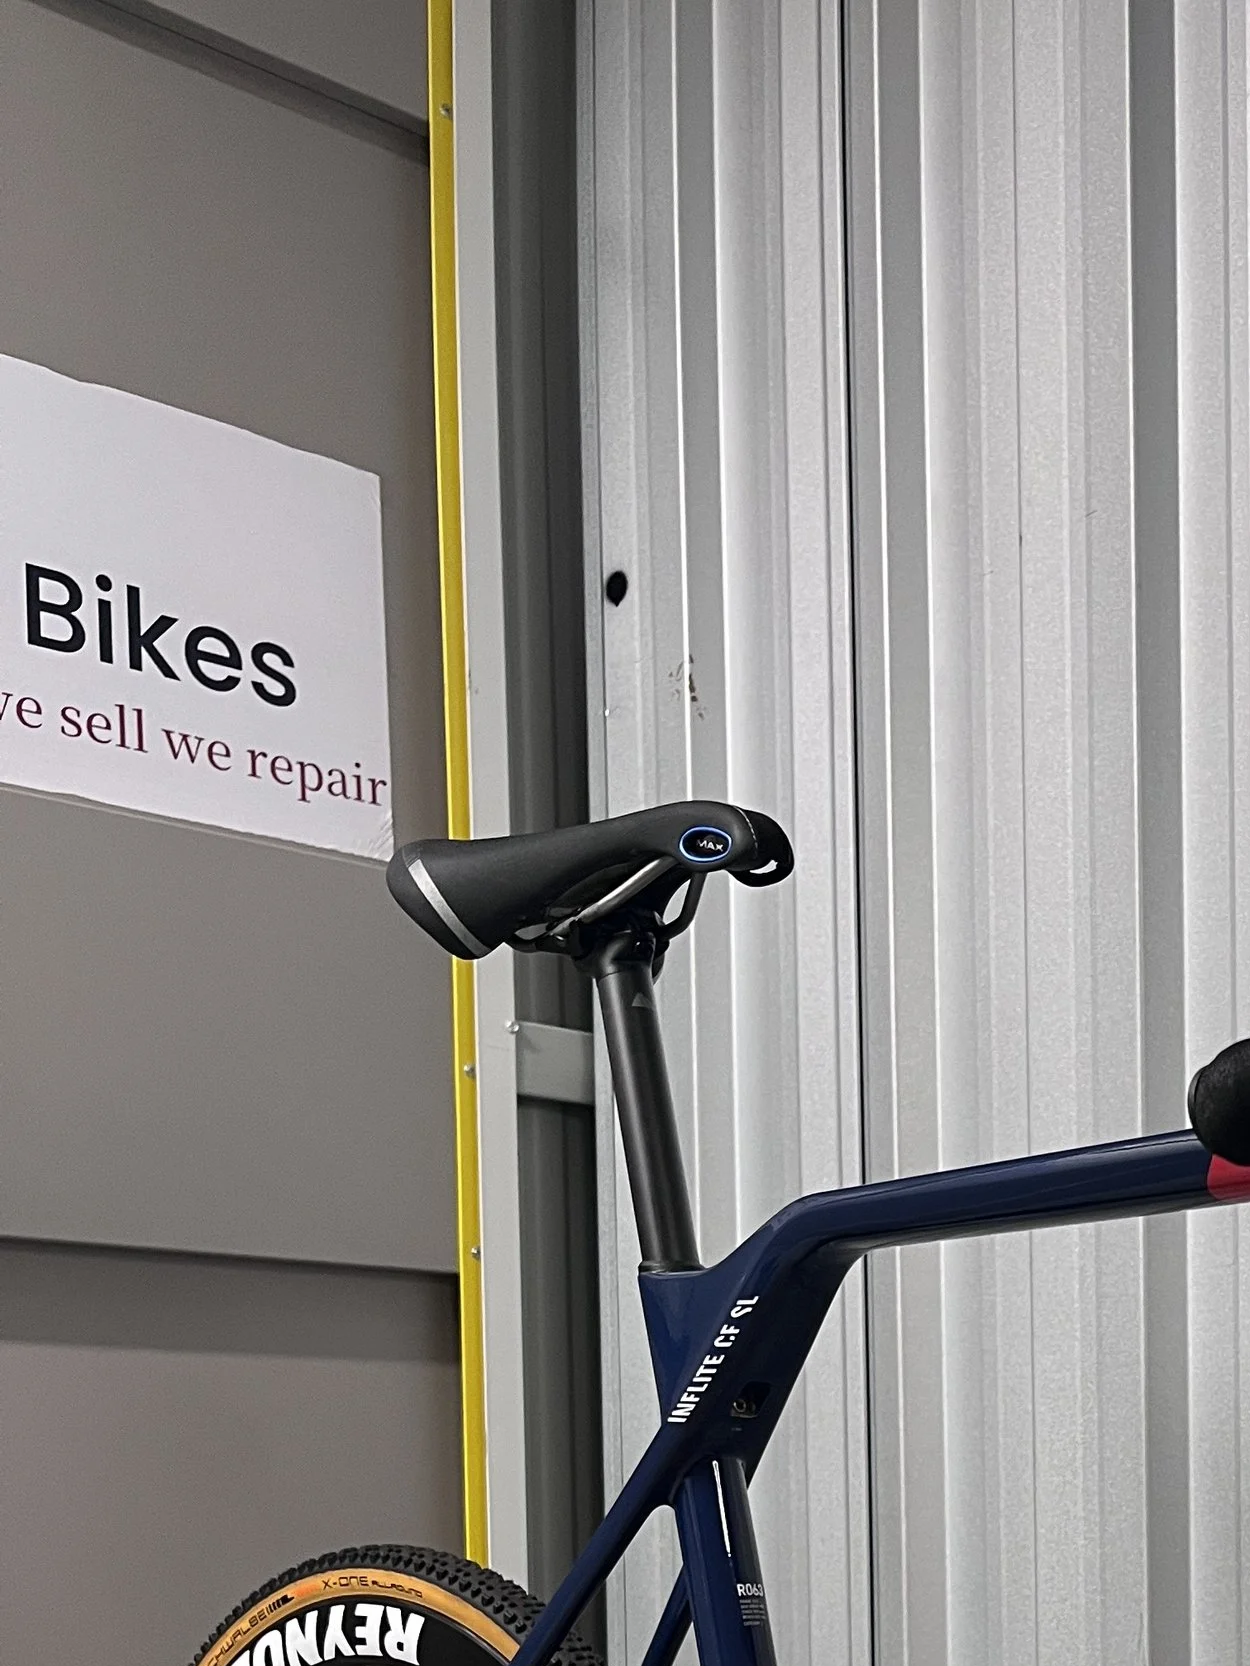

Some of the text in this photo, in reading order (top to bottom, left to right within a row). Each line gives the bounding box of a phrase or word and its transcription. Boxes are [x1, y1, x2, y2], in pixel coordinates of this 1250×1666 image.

[25, 562, 297, 707] Bikes
[60, 703, 148, 754] sell
[161, 728, 231, 772] we
[246, 749, 387, 806] repair
[667, 1295, 759, 1423] INFLITE CF SL
[322, 1575, 370, 1591] X-ONE
